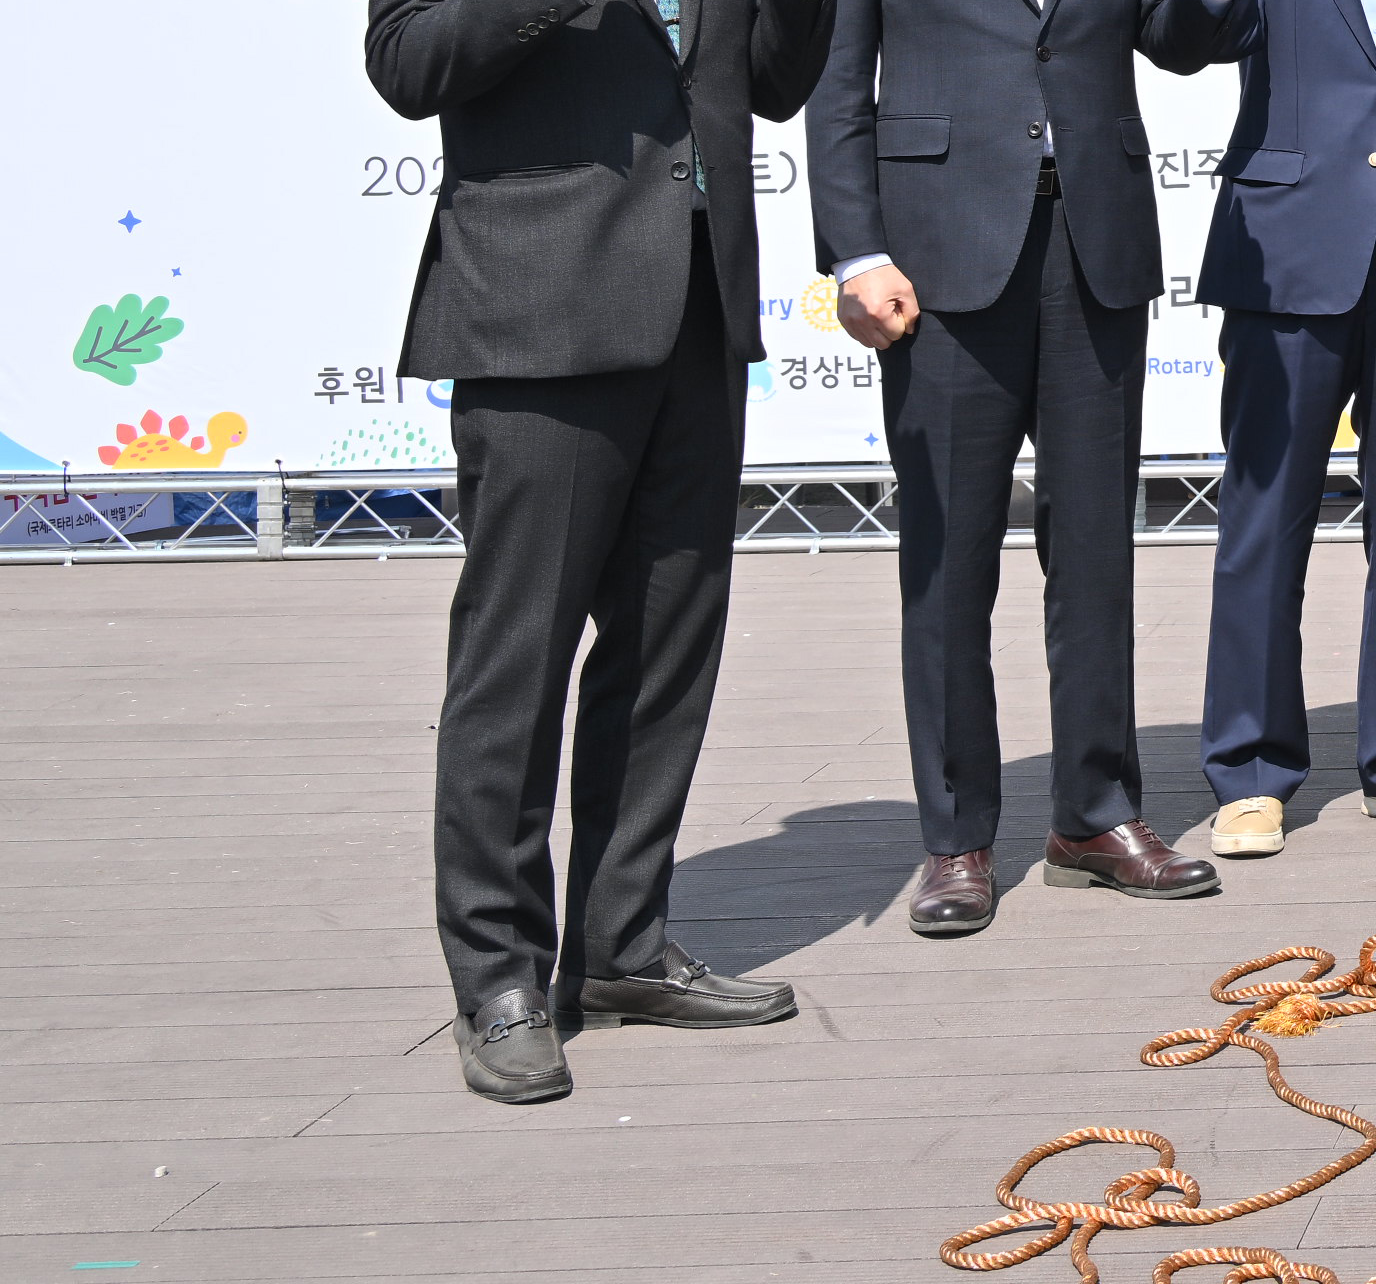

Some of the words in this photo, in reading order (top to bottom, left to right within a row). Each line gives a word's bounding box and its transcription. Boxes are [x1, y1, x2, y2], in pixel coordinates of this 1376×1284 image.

[314, 367, 385, 405] 후원
[780, 355, 883, 391] 경상남
[1148, 357, 1214, 377] Rotary
